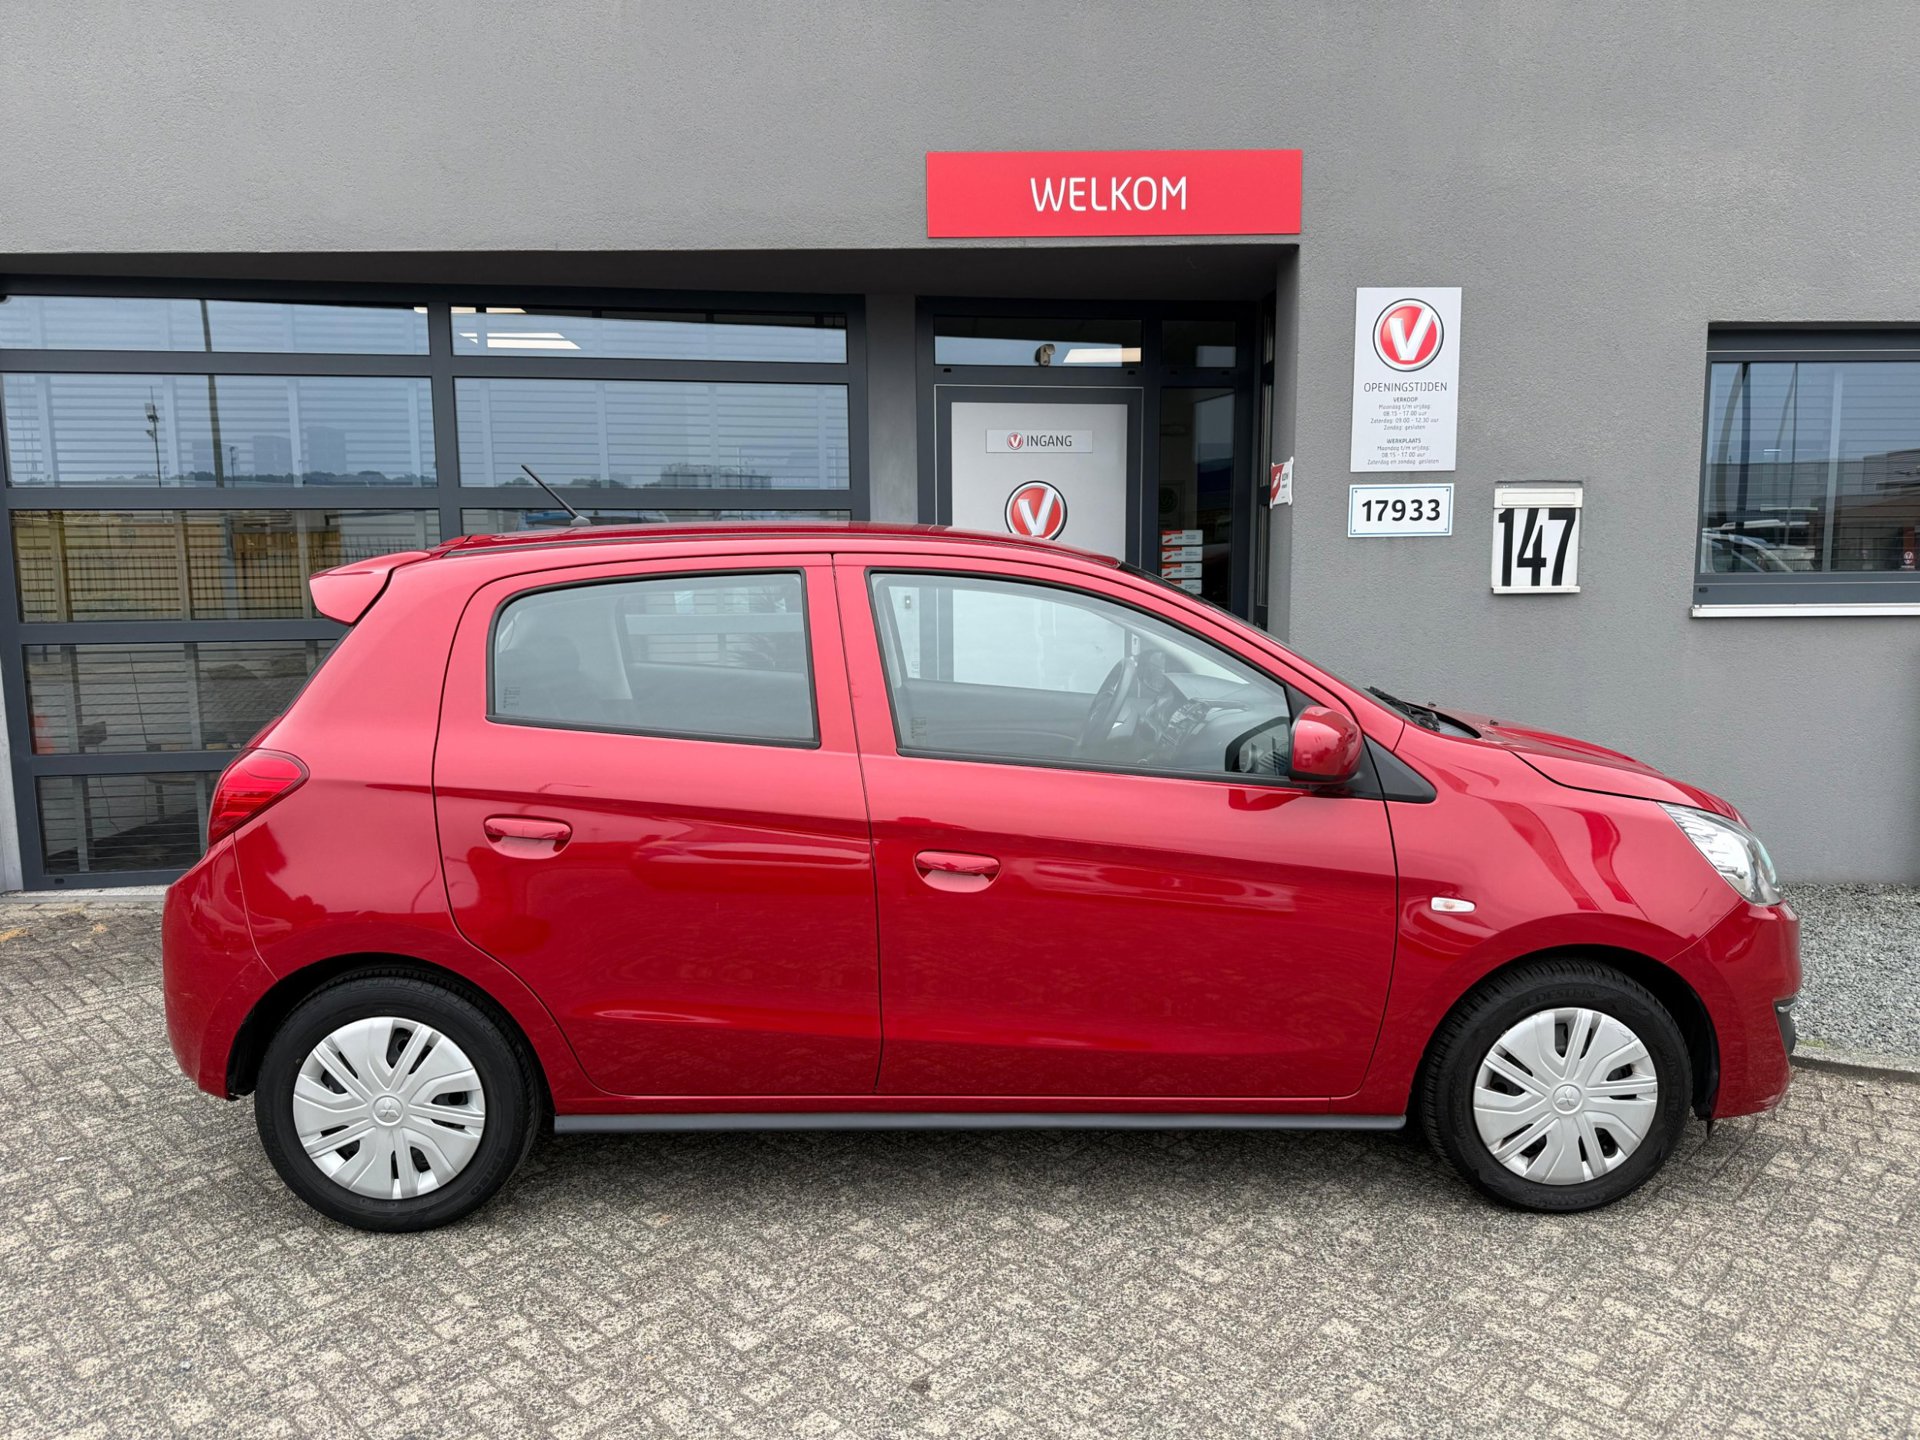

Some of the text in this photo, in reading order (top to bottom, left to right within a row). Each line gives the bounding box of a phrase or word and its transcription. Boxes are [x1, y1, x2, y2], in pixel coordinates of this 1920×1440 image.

[1030, 176, 1187, 212] WELKOM
[1363, 382, 1448, 393] OPENINGSTIJDEN
[1026, 435, 1073, 447] INGANG
[1361, 498, 1441, 522] 17933
[1498, 507, 1577, 587] 147
